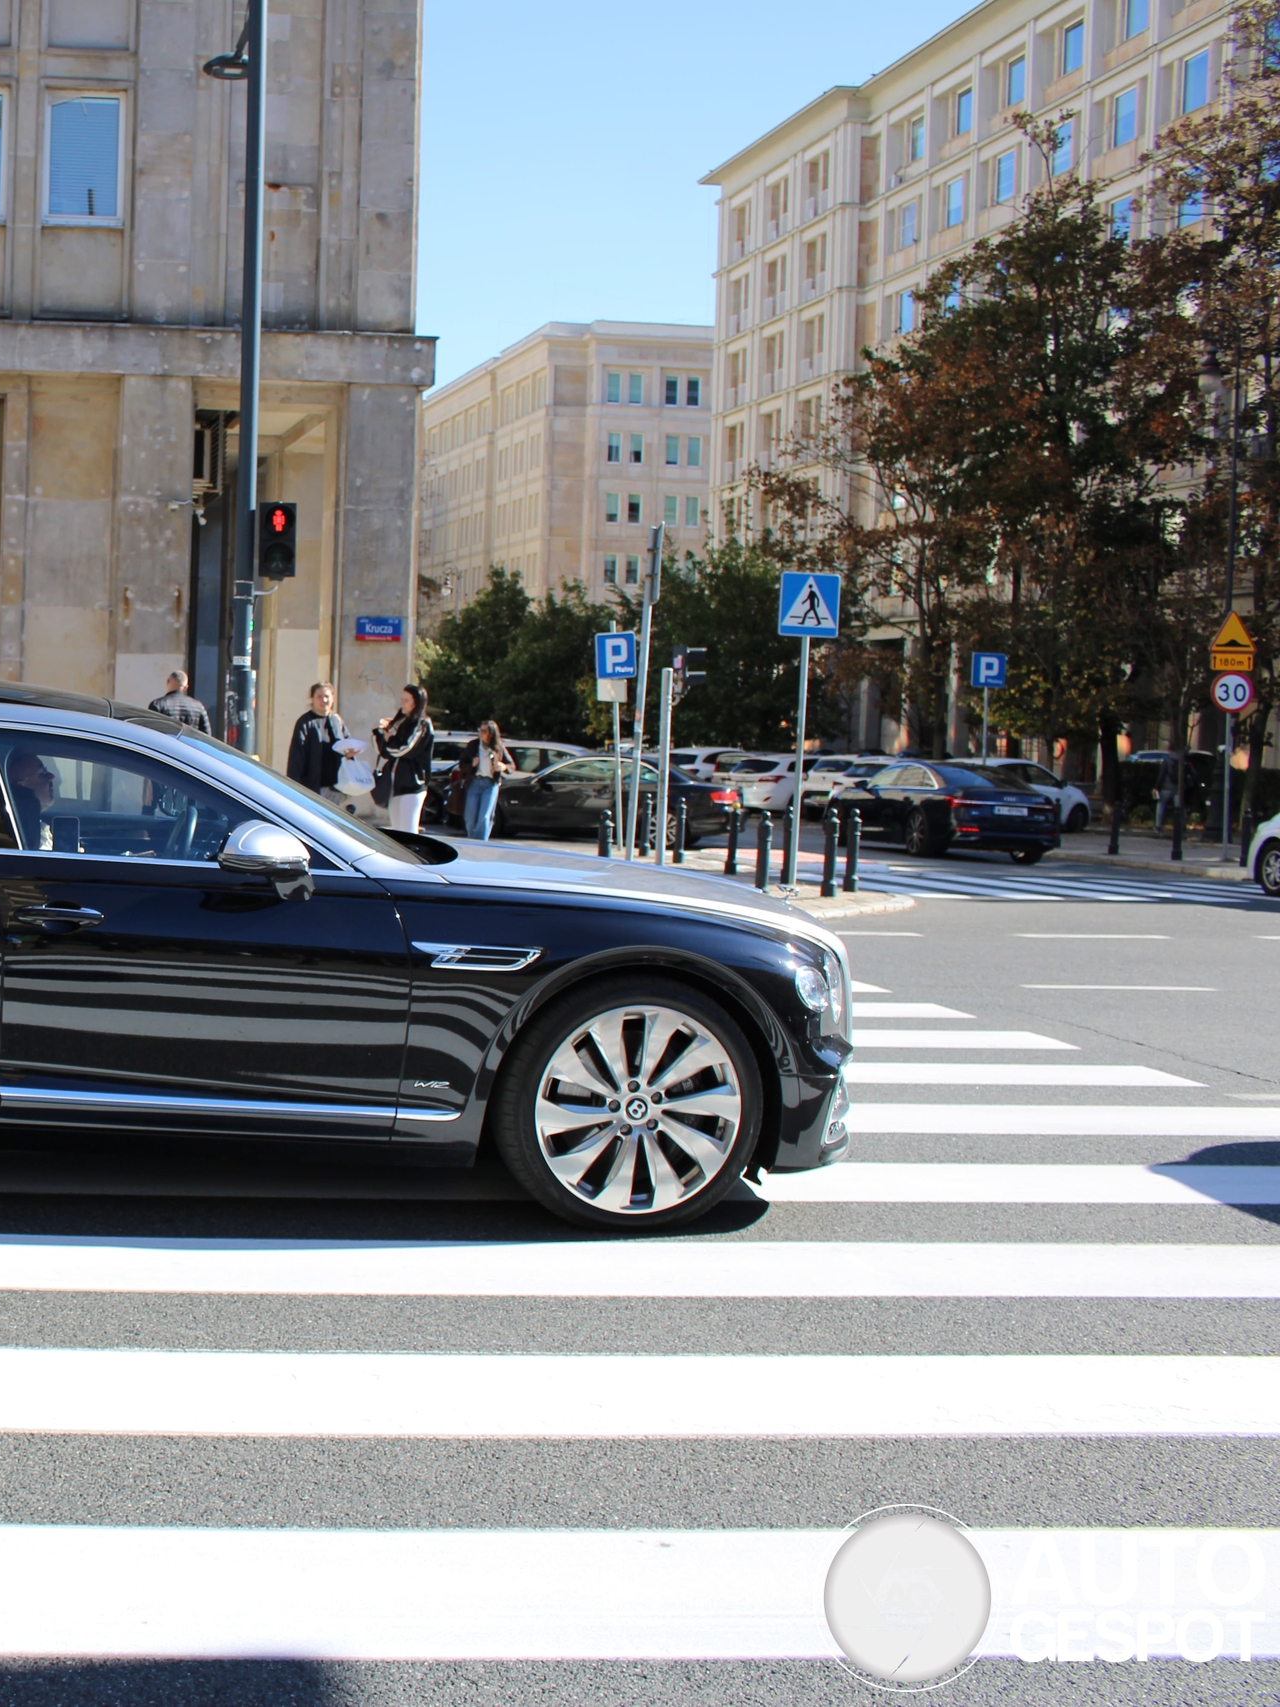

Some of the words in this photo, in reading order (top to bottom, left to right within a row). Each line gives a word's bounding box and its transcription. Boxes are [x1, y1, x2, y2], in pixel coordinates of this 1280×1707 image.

[365, 624, 393, 634] Krucza
[605, 638, 628, 673] P
[980, 656, 999, 683] P
[1218, 683, 1247, 702] 30
[413, 1080, 450, 1089] W12
